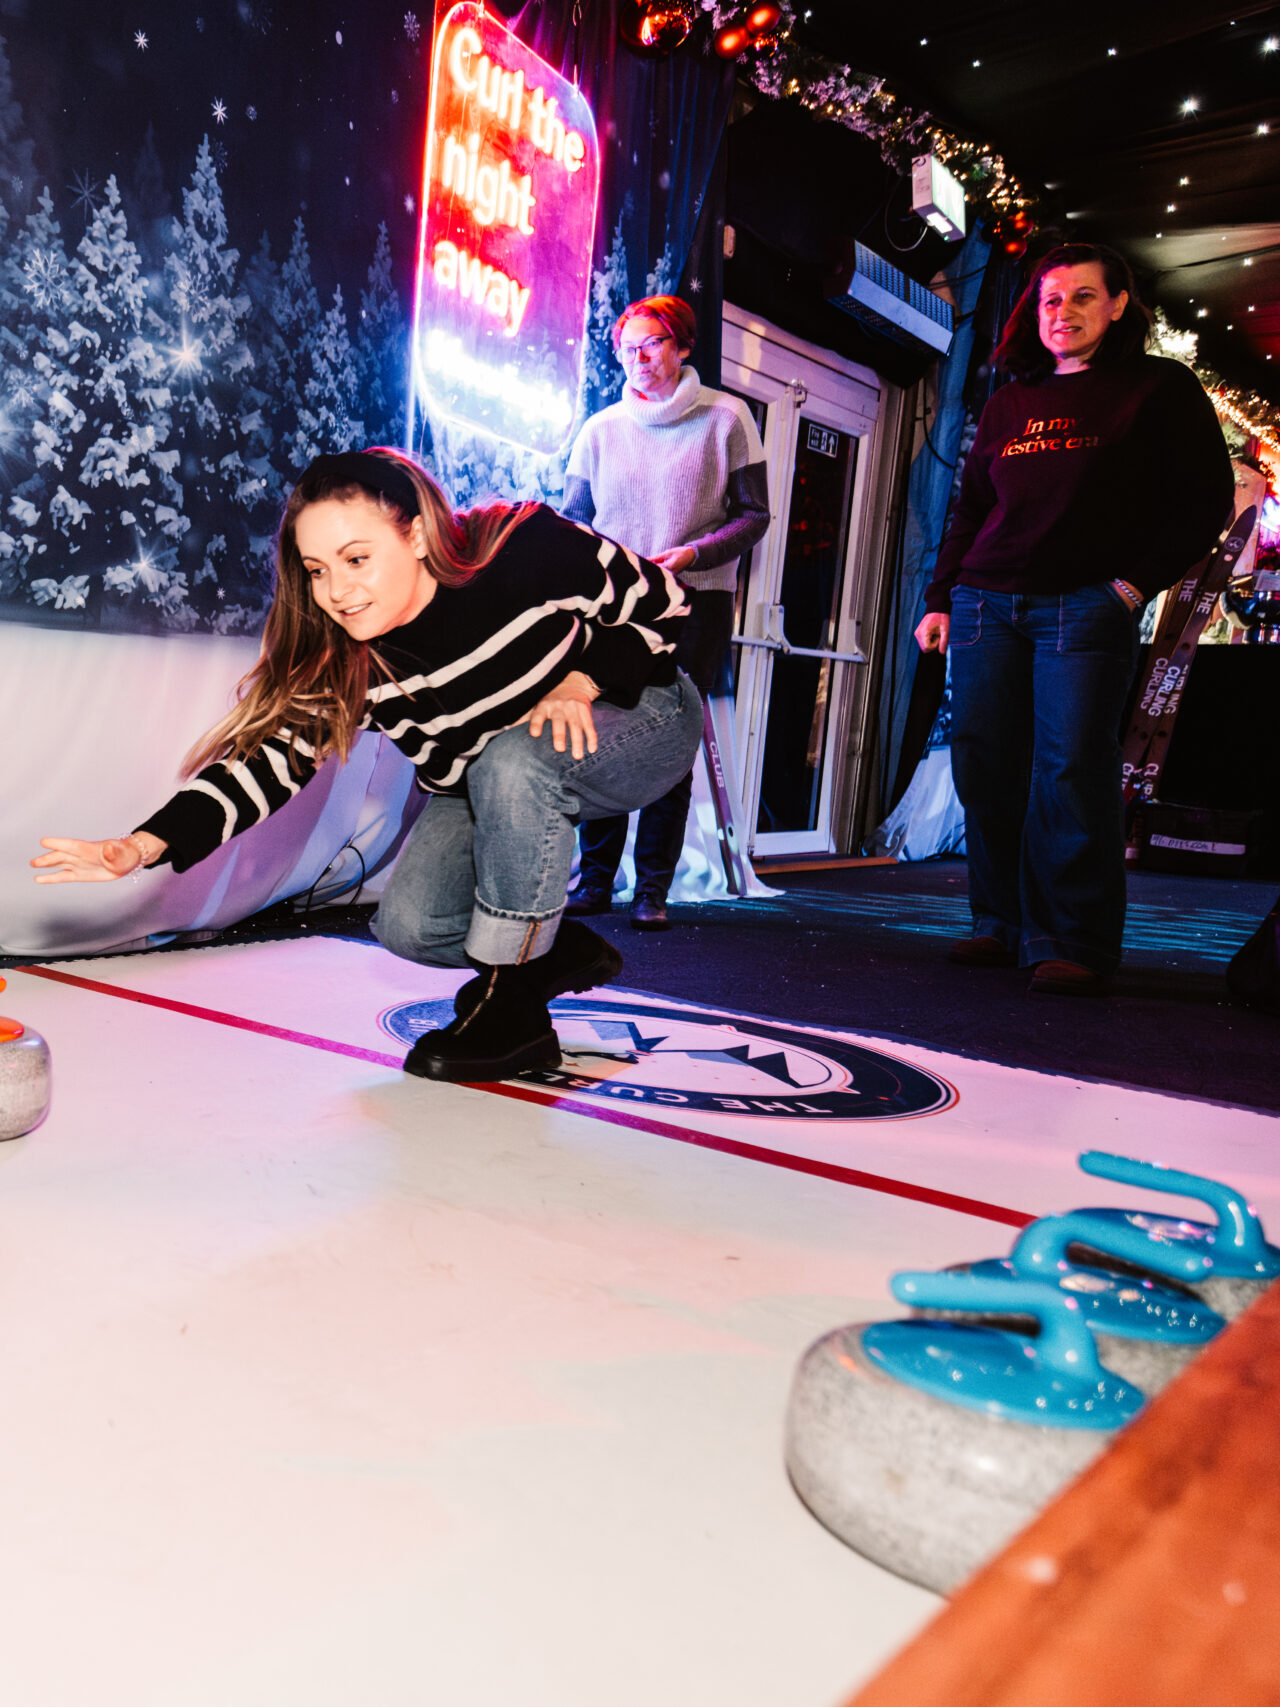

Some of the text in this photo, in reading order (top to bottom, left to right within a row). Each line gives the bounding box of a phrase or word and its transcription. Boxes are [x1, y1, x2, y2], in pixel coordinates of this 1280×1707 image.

[449, 27, 586, 172] Curl the
[442, 133, 536, 235] night
[433, 240, 530, 338] away
[1000, 435, 1061, 458] festive
[1023, 418, 1045, 436] In
[1196, 592, 1218, 615] THE
[1140, 578, 1198, 710] THE CURLING
[1148, 666, 1180, 717] CURLING
[710, 741, 725, 788] CLUB
[712, 1097, 834, 1114] THE
